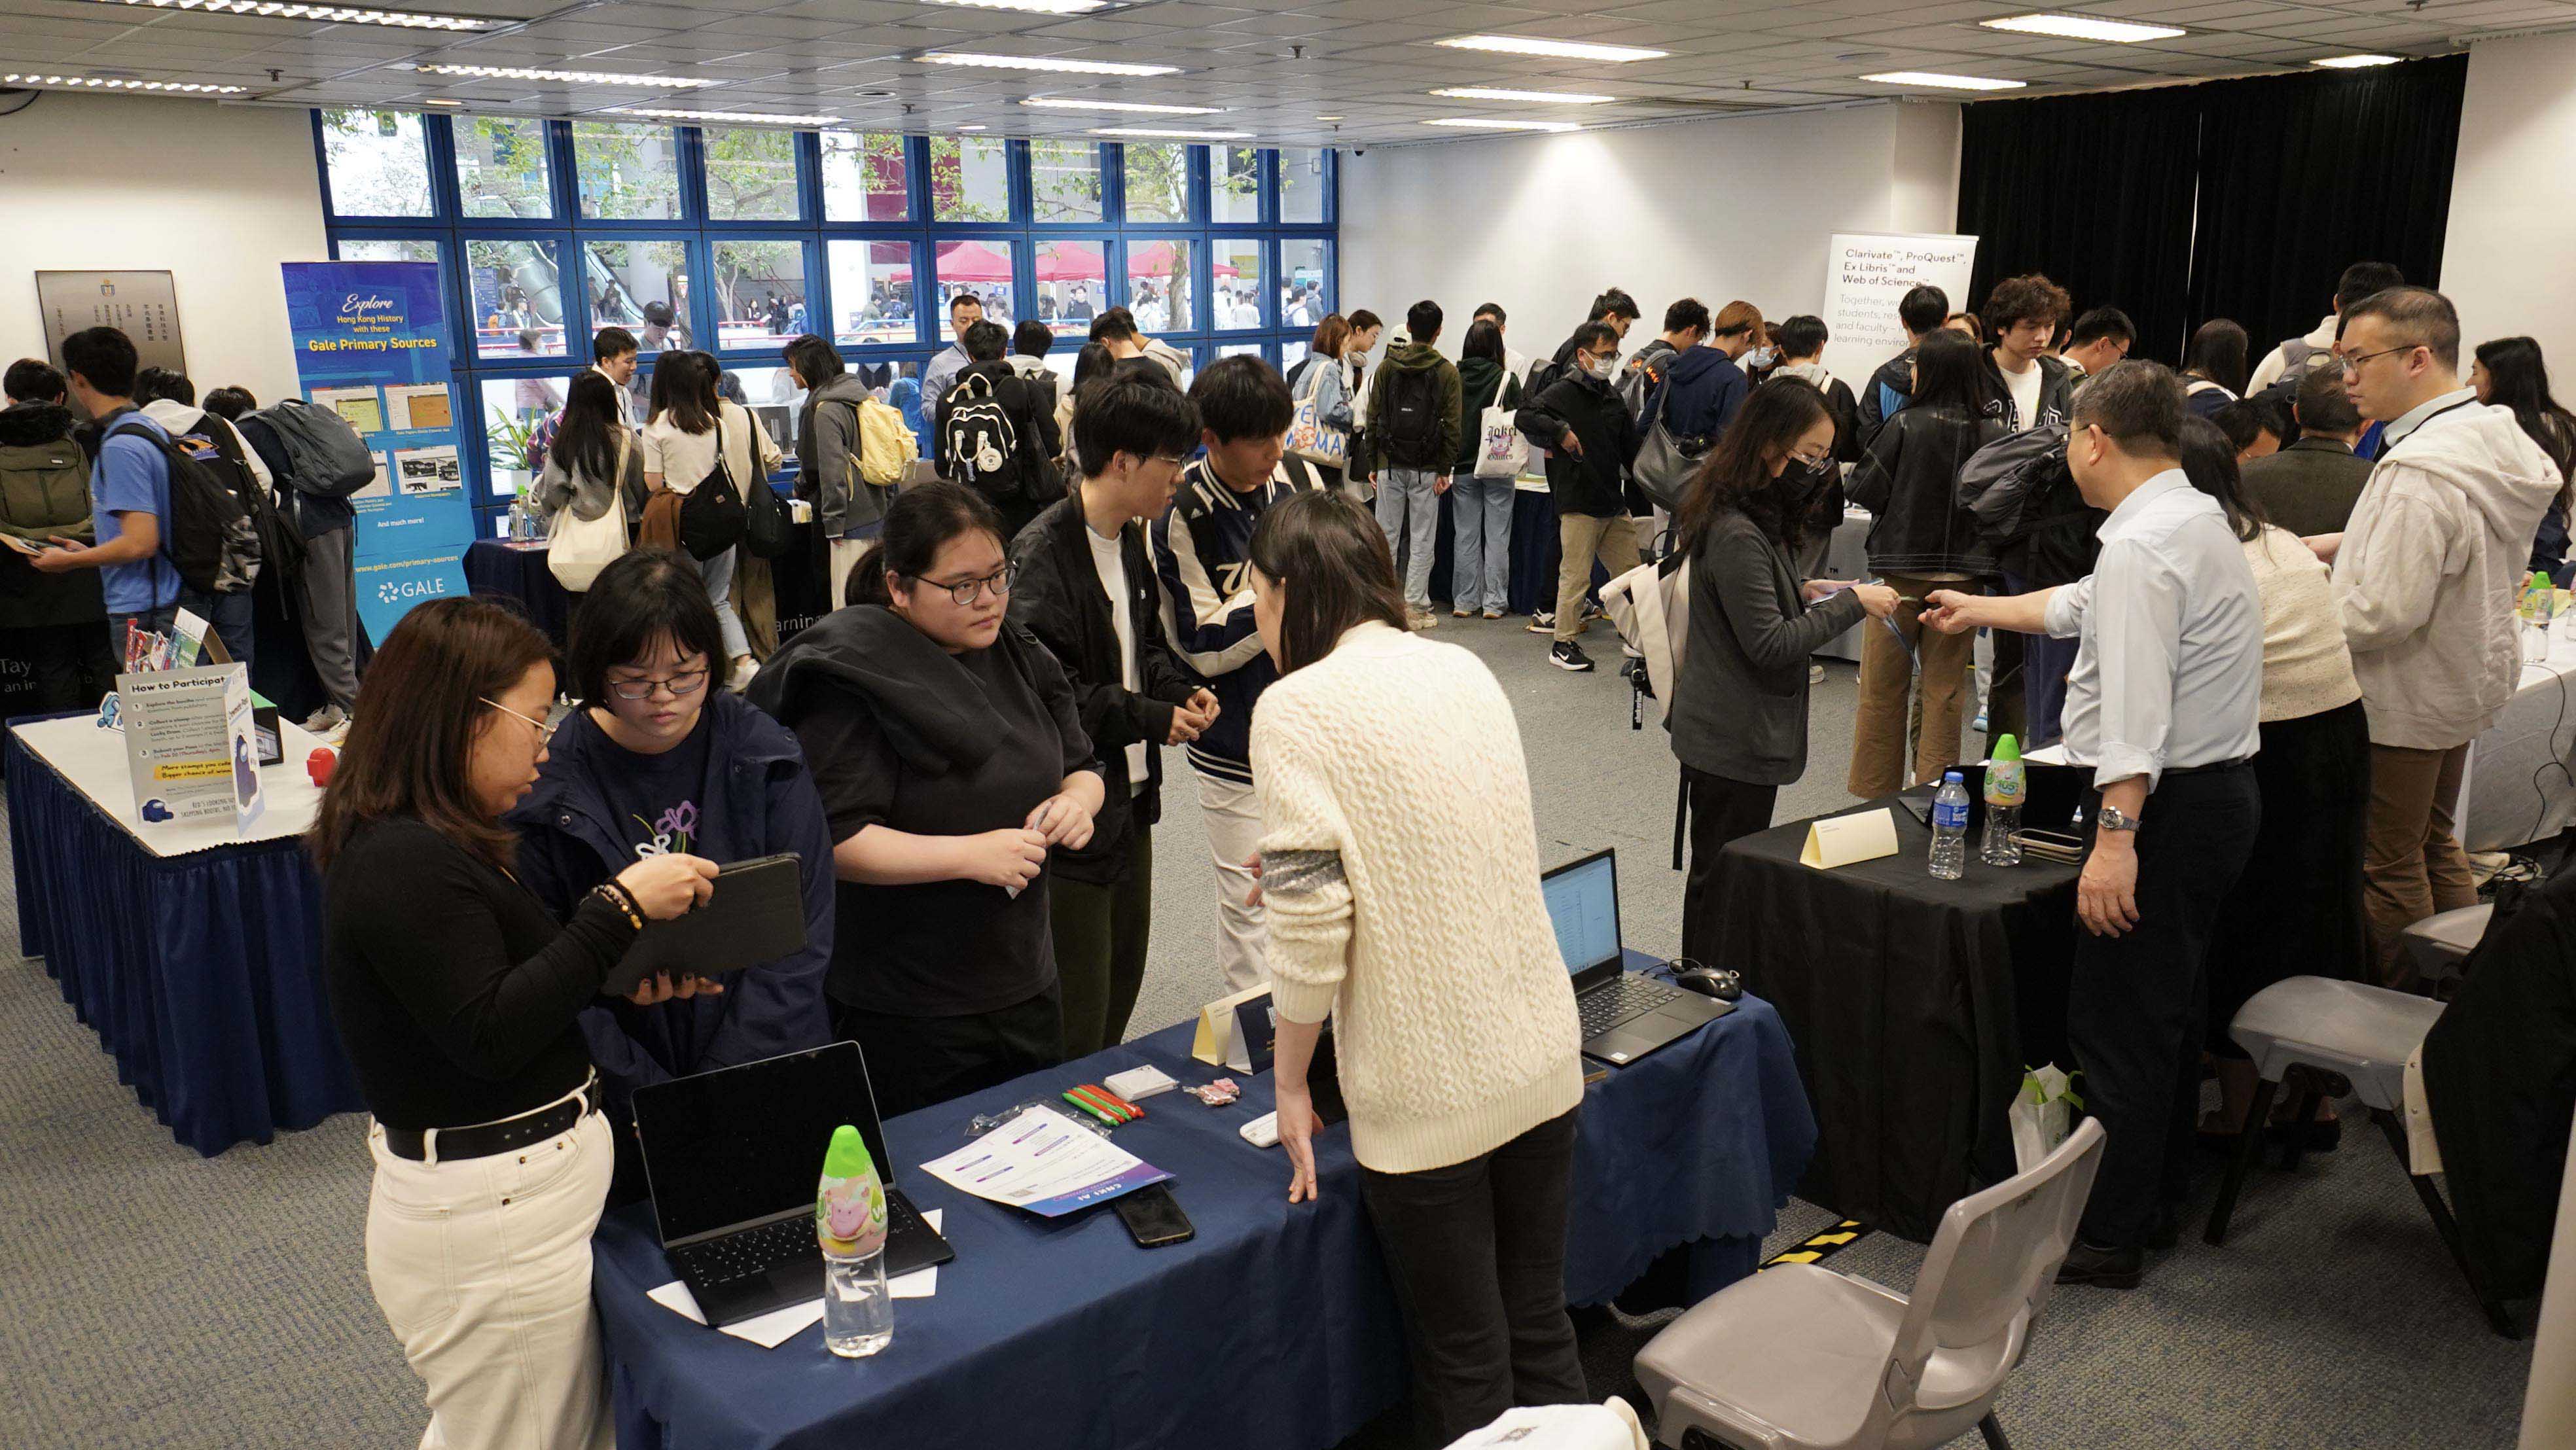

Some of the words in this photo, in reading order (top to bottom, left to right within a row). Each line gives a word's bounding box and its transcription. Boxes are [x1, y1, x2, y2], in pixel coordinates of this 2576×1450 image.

[1844, 262, 1856, 271] Ex
[1842, 274, 1867, 285] Web
[1869, 276, 1880, 285] of
[342, 293, 393, 316] Explore
[1840, 294, 1886, 307] Together,
[337, 316, 356, 325] Hong
[357, 315, 376, 325] Kong
[377, 315, 404, 323] History
[1837, 309, 1881, 320] students,
[1856, 322, 1888, 334] faculty
[309, 340, 337, 351] Gale
[340, 339, 387, 352] Primary
[391, 338, 437, 349] Sources
[1834, 334, 1873, 347] learning
[401, 578, 445, 597] GALE
[0, 658, 31, 677] Tay
[132, 684, 156, 694] How
[159, 682, 170, 690] to
[173, 676, 226, 689] Participat
